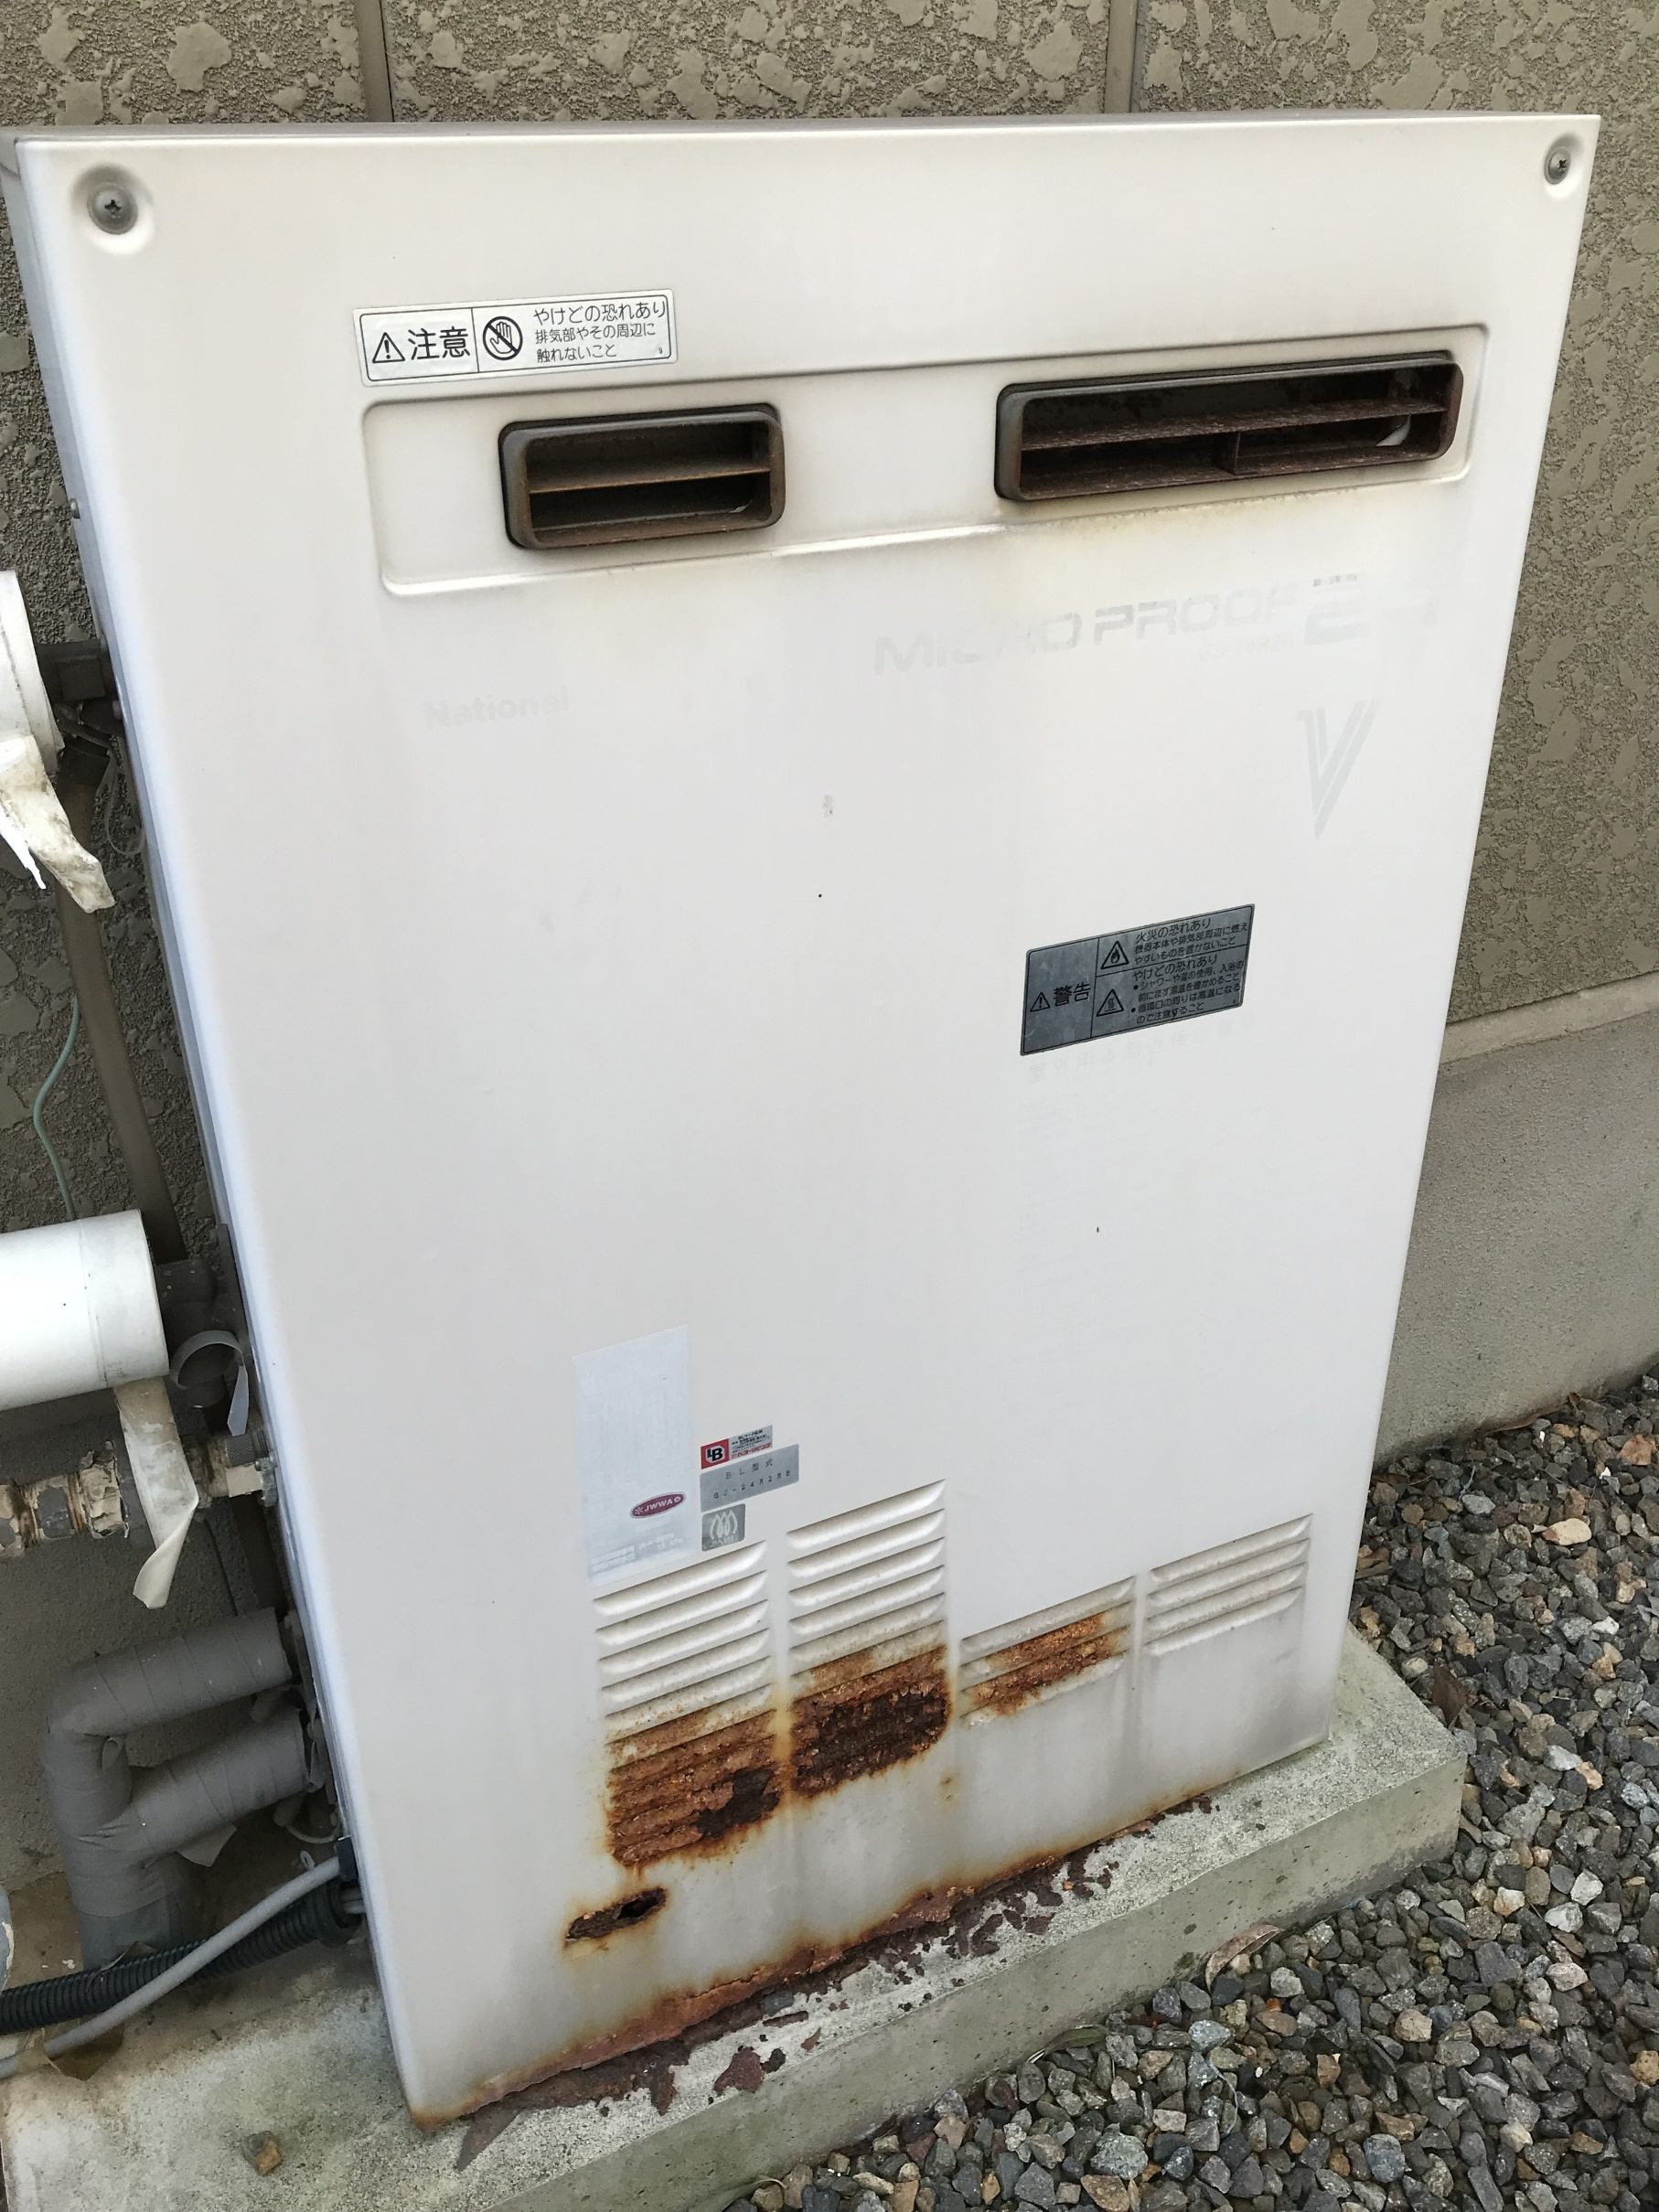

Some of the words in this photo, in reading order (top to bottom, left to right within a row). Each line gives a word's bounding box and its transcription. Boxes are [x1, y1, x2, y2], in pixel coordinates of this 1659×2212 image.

[408, 326, 471, 361] 注意
[533, 301, 666, 326] やけどの恐れあり
[535, 323, 656, 345] 排気部やその周辺に
[537, 343, 617, 364] 触れないこと
[1093, 583, 1297, 646] PROOF
[423, 684, 569, 729] National
[1136, 917, 1212, 943] 火災の恐れあり
[1134, 936, 1236, 965] やすいものを置かないこと
[1132, 954, 1217, 981] やけどの恐れあり
[1054, 981, 1091, 1006] 警告
[644, 1499, 673, 1512] JWWA
